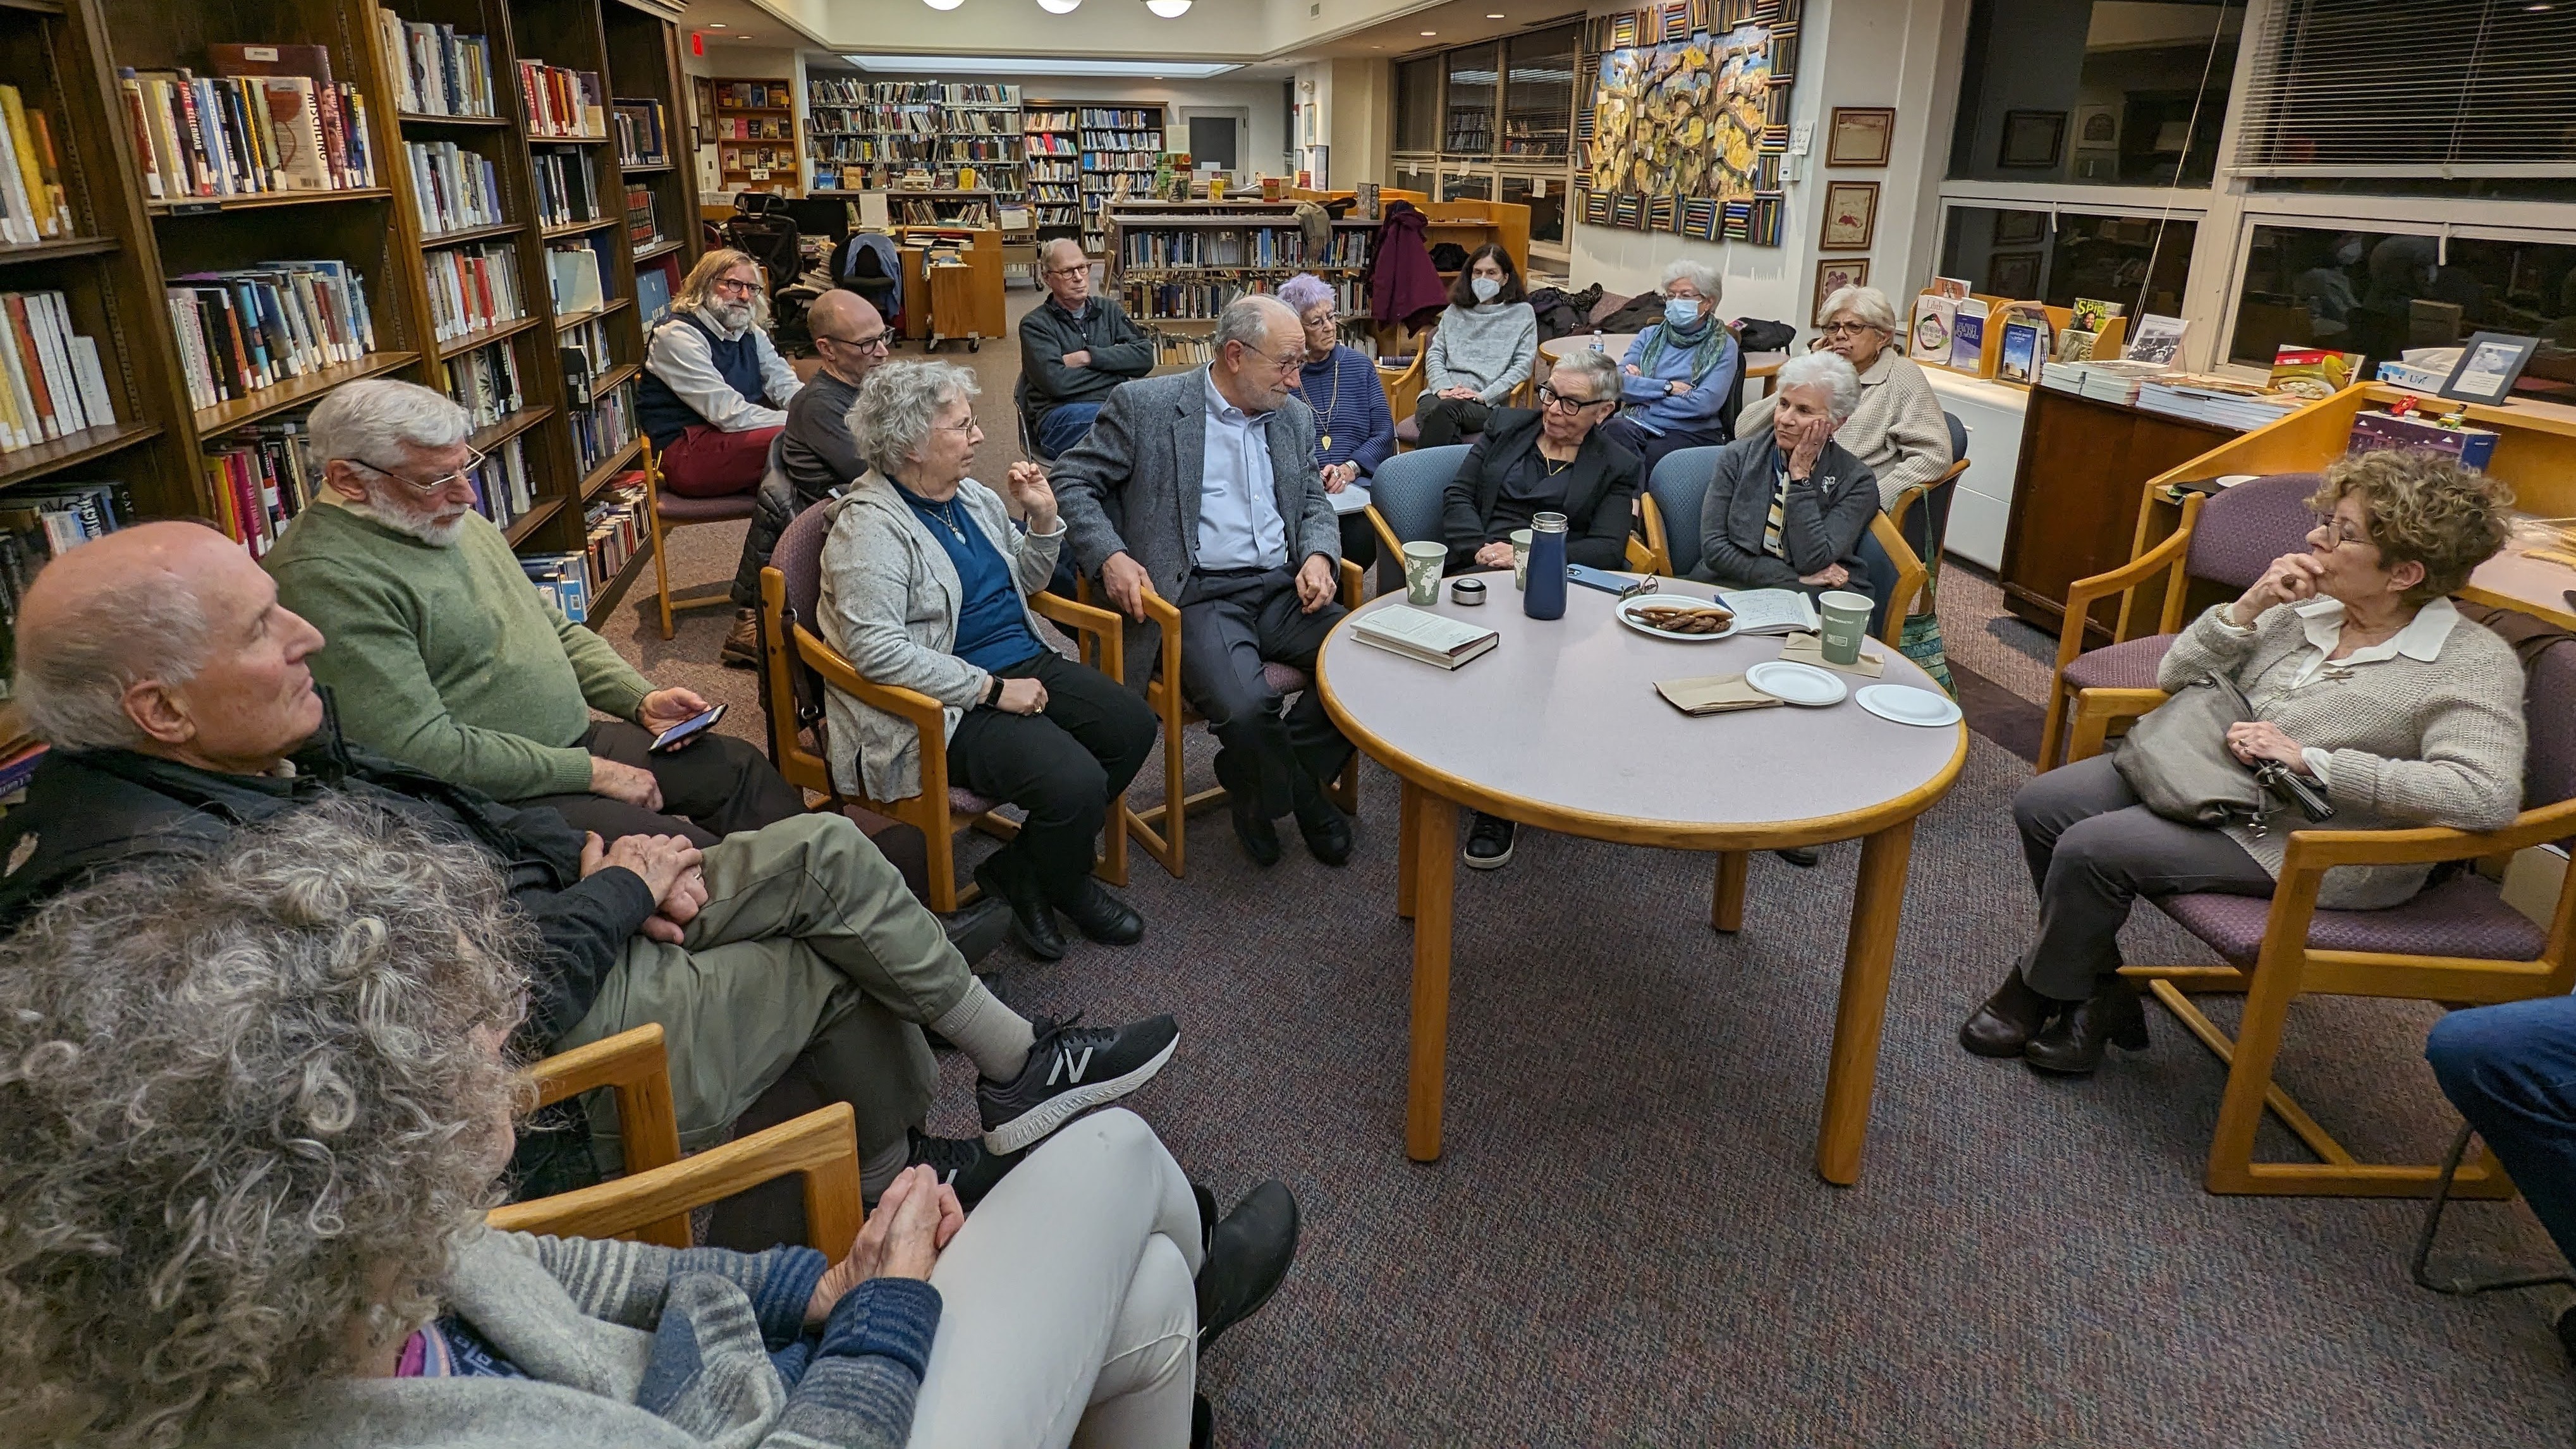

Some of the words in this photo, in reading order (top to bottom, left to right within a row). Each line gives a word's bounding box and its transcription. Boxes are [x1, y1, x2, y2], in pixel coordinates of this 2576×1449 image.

[307, 92, 326, 161] MISCHLING
[1927, 300, 1943, 312] Lilith
[1046, 1047, 1094, 1085] N
